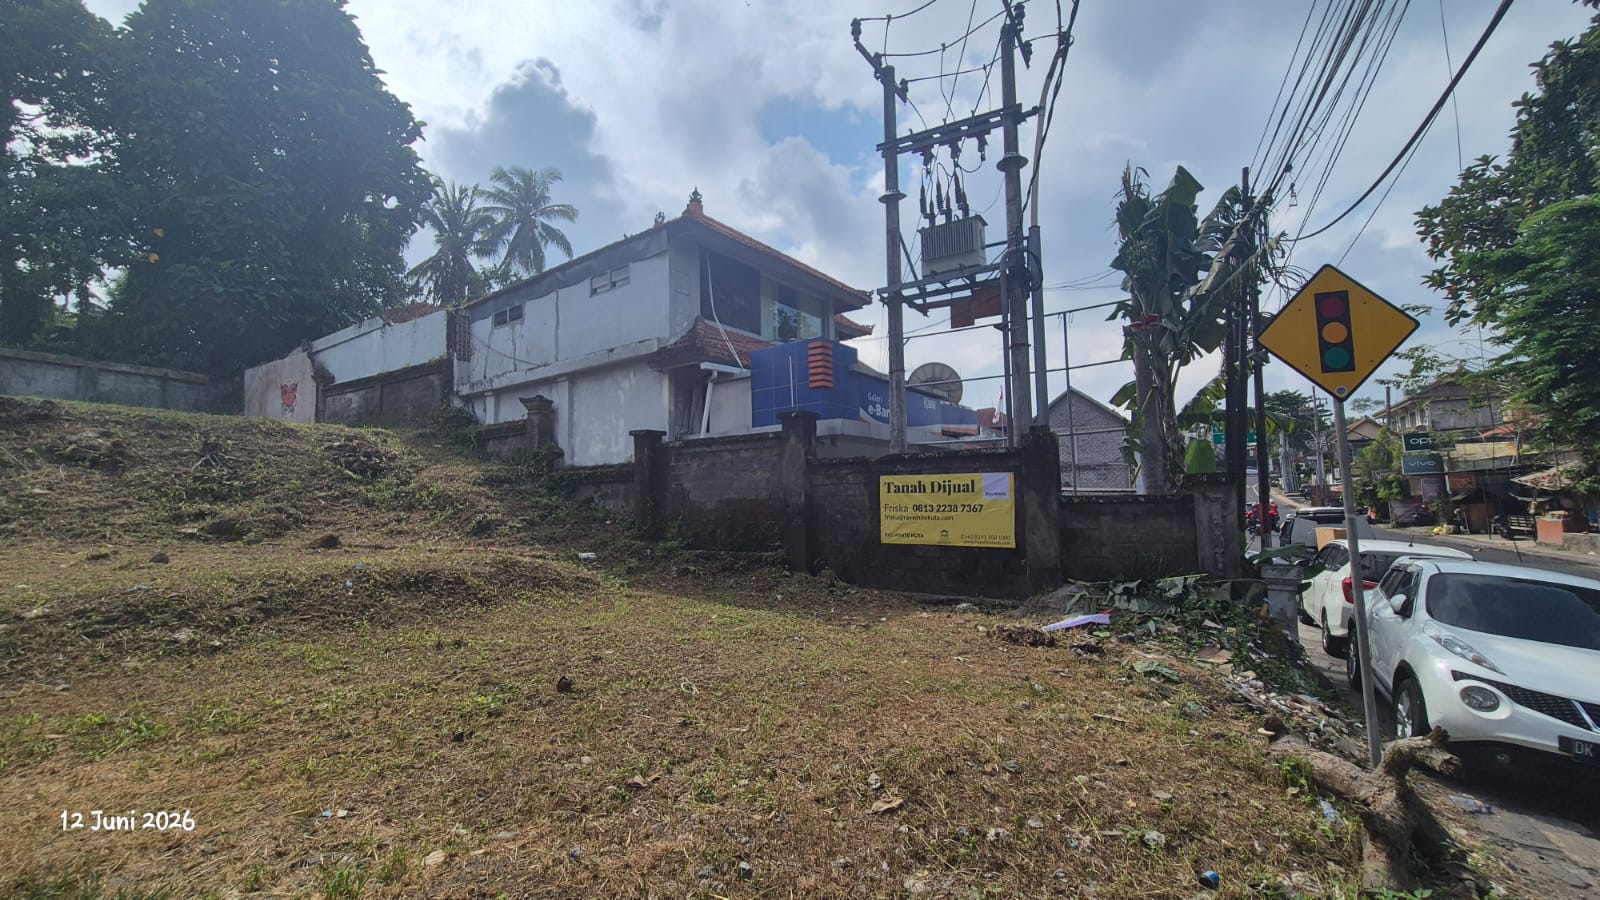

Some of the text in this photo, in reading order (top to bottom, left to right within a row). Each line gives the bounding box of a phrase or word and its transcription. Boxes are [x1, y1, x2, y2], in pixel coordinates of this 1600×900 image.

[884, 480, 975, 496] Tanah Dijual
[884, 503, 983, 513] Friska 0813 2238 7367
[1575, 741, 1593, 757] DK
